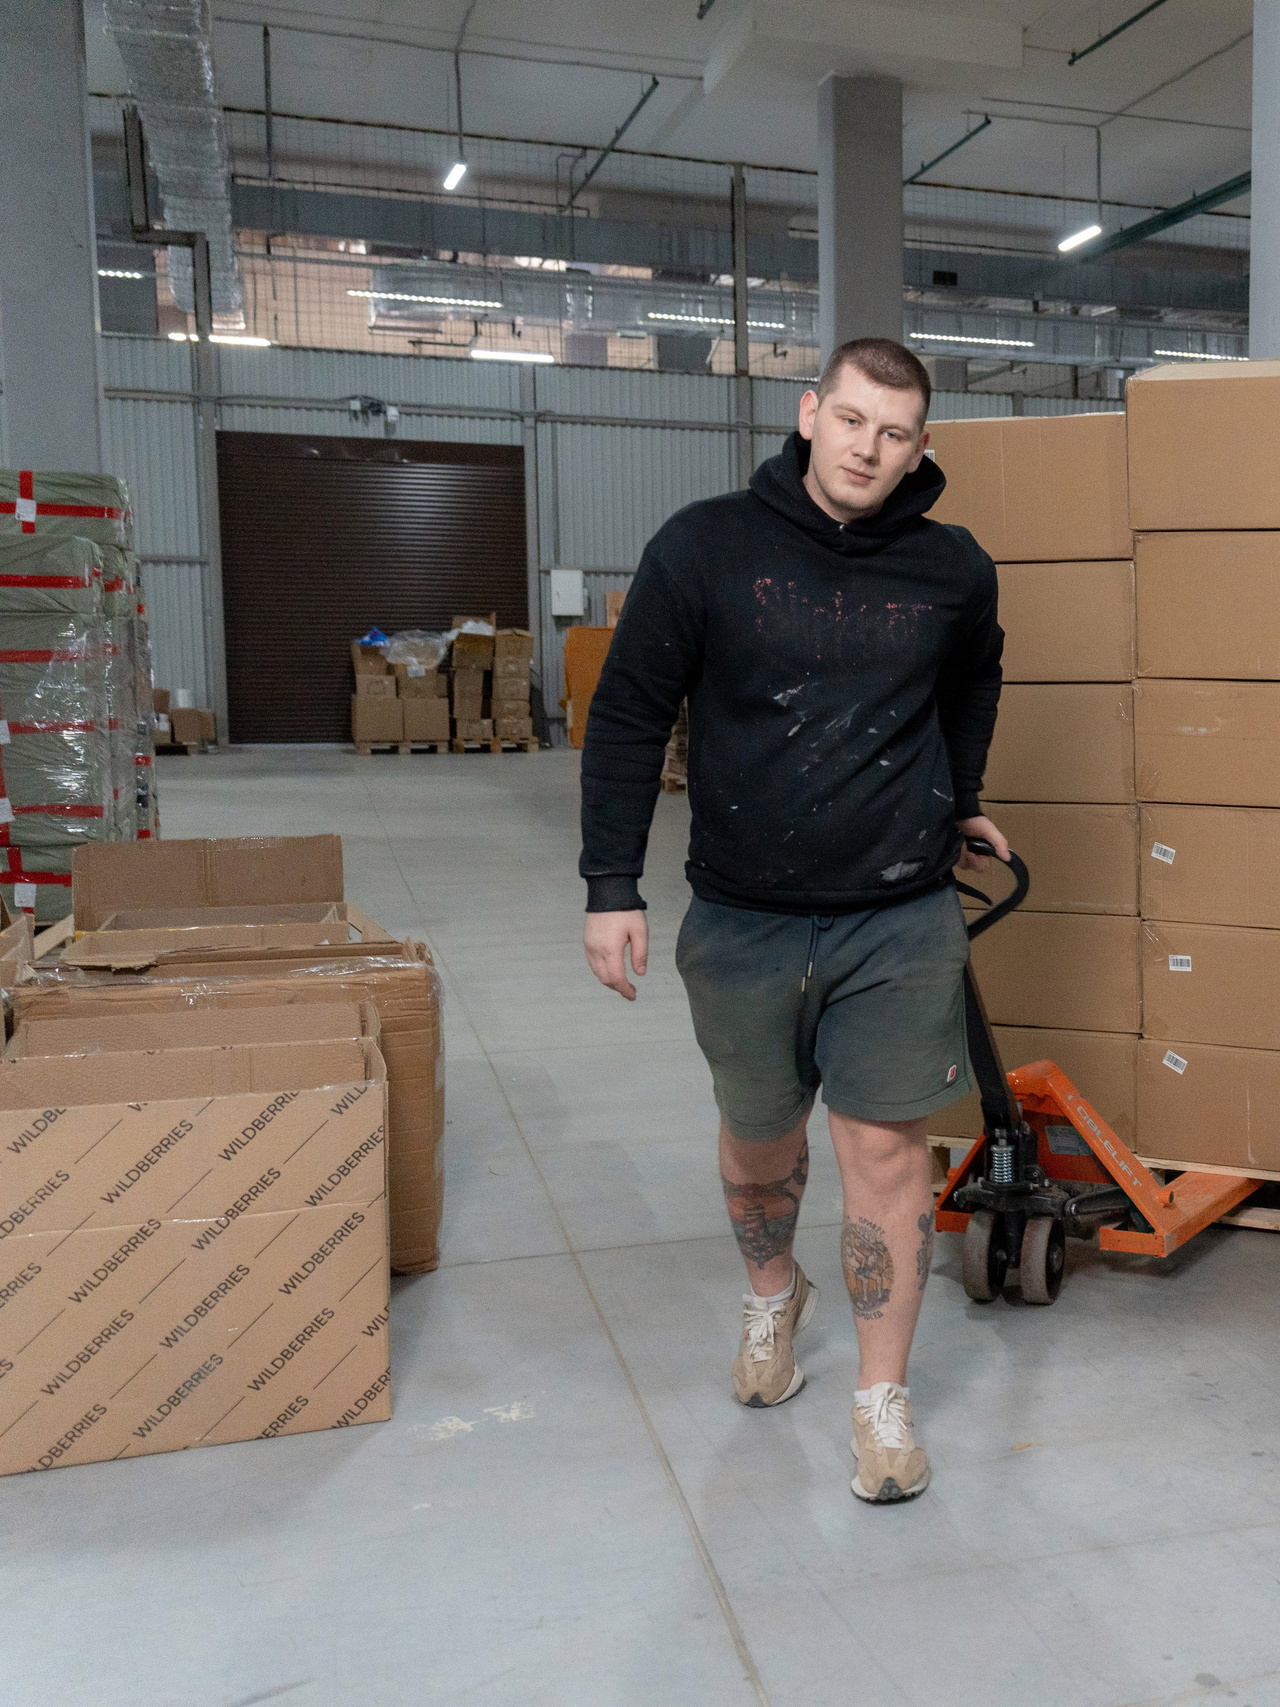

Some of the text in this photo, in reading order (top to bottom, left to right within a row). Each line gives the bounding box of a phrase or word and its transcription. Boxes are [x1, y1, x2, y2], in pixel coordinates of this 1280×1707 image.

[100, 1119, 194, 1204] WILDBERRIES
[1067, 1095, 1142, 1187] OBLELIFT
[192, 1167, 281, 1252] WILDBERRIES
[68, 1218, 162, 1304] WILDBERRIES
[279, 1211, 365, 1296] WILDBERRIES
[160, 1263, 251, 1350] WILDBERRIES
[247, 1307, 335, 1392] WILDBERRIES
[40, 1309, 135, 1396] WILDBERRIES
[133, 1353, 224, 1439] WILDBERRIES
